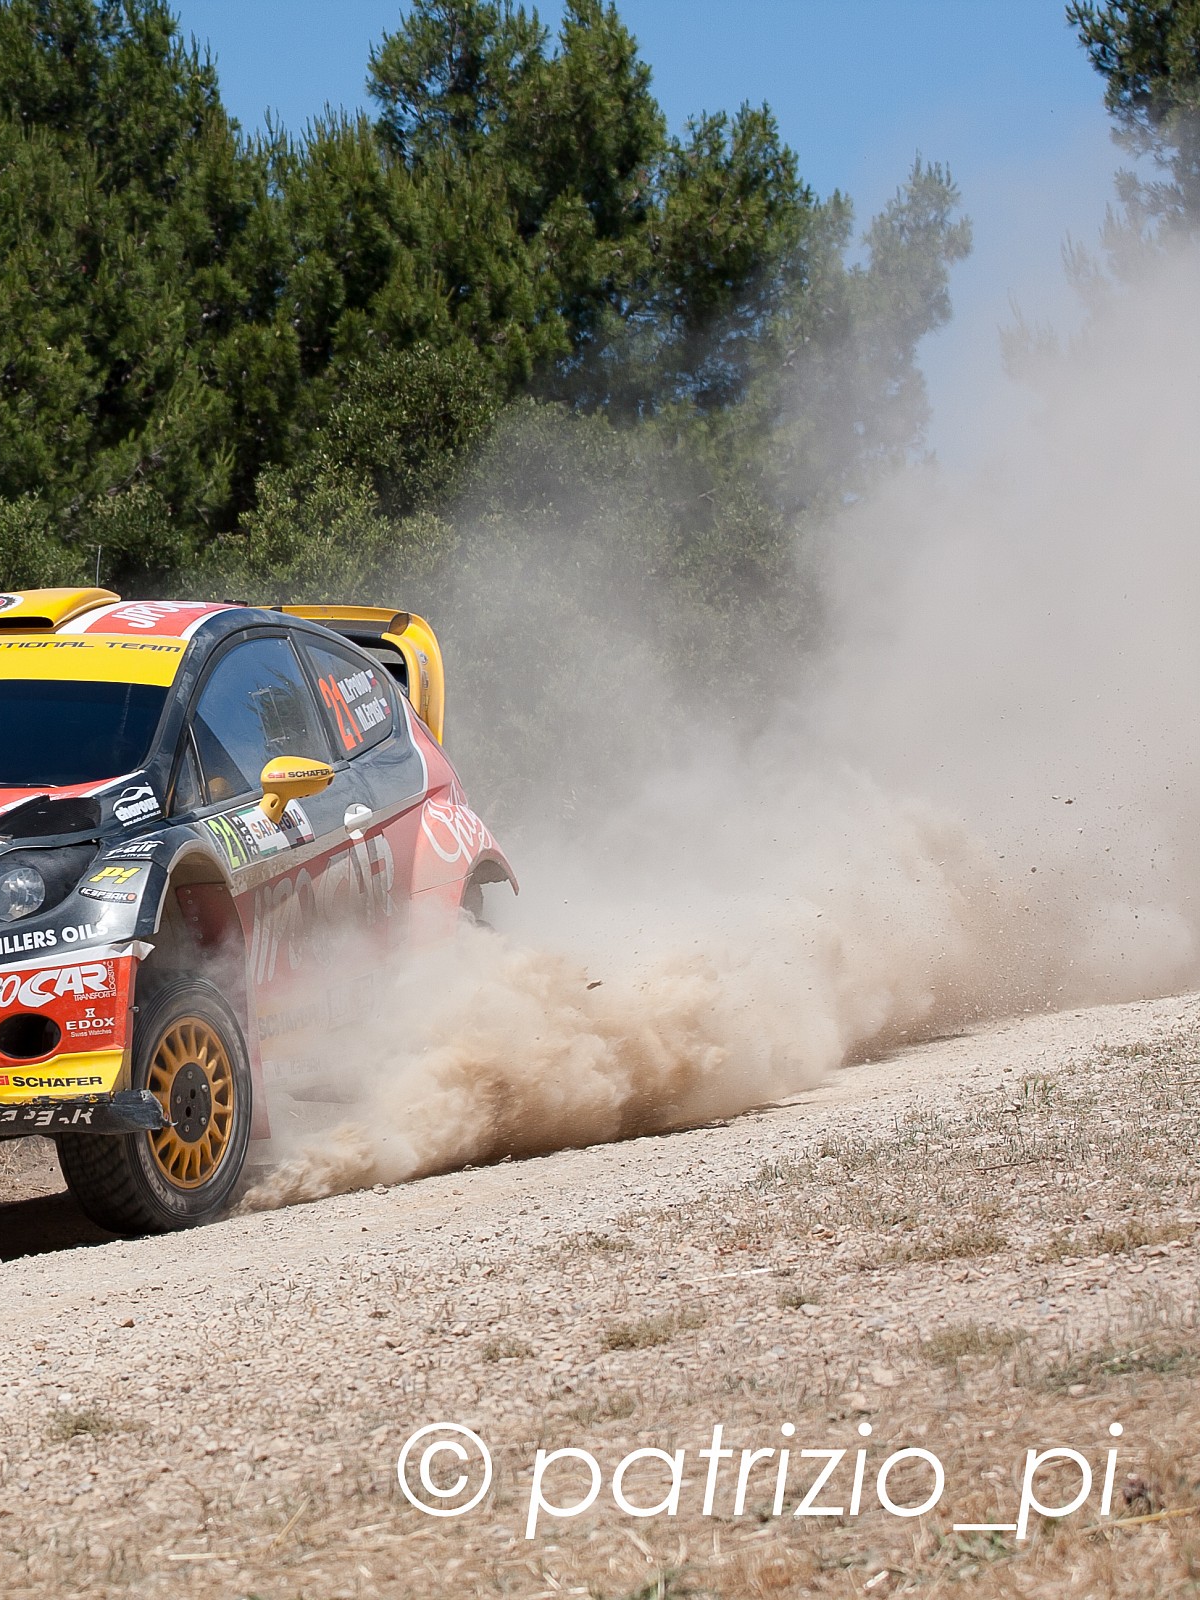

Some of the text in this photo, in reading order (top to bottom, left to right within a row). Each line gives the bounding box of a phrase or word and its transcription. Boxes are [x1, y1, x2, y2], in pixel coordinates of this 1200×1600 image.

[105, 642, 181, 653] TEAM
[319, 674, 363, 751] 21
[207, 816, 247, 869] 21
[88, 866, 142, 884] P1
[62, 922, 109, 943] OILS
[66, 1017, 115, 1030] EDOX
